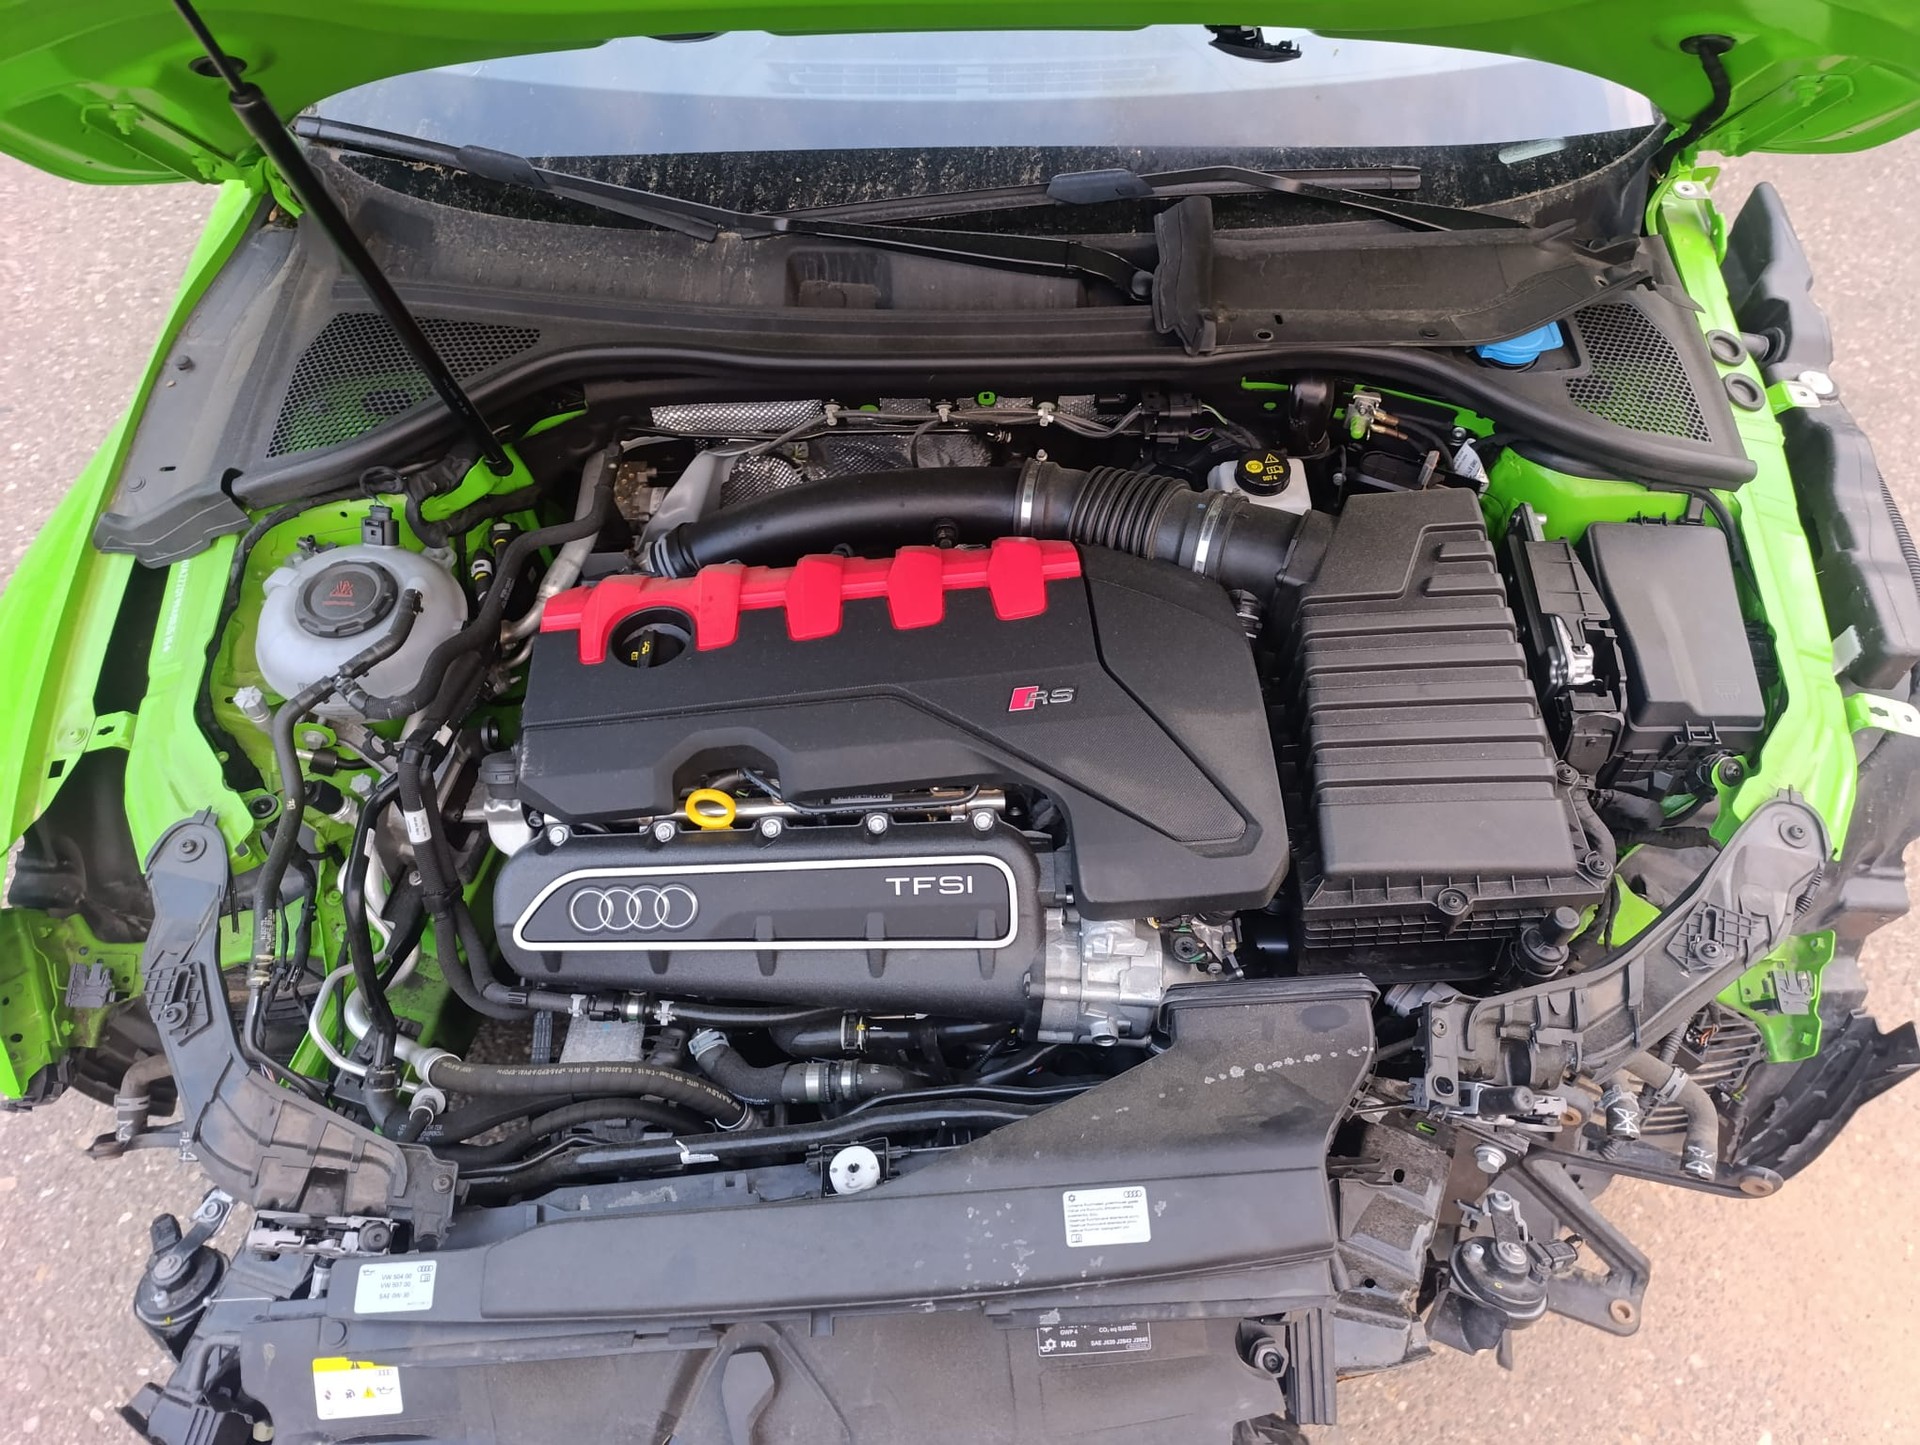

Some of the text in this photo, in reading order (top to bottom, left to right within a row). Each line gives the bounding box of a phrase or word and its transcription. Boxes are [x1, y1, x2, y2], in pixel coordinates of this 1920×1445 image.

[1022, 686, 1075, 707] RS
[885, 875, 973, 896] TFSI
[1060, 1340, 1077, 1348] PAG
